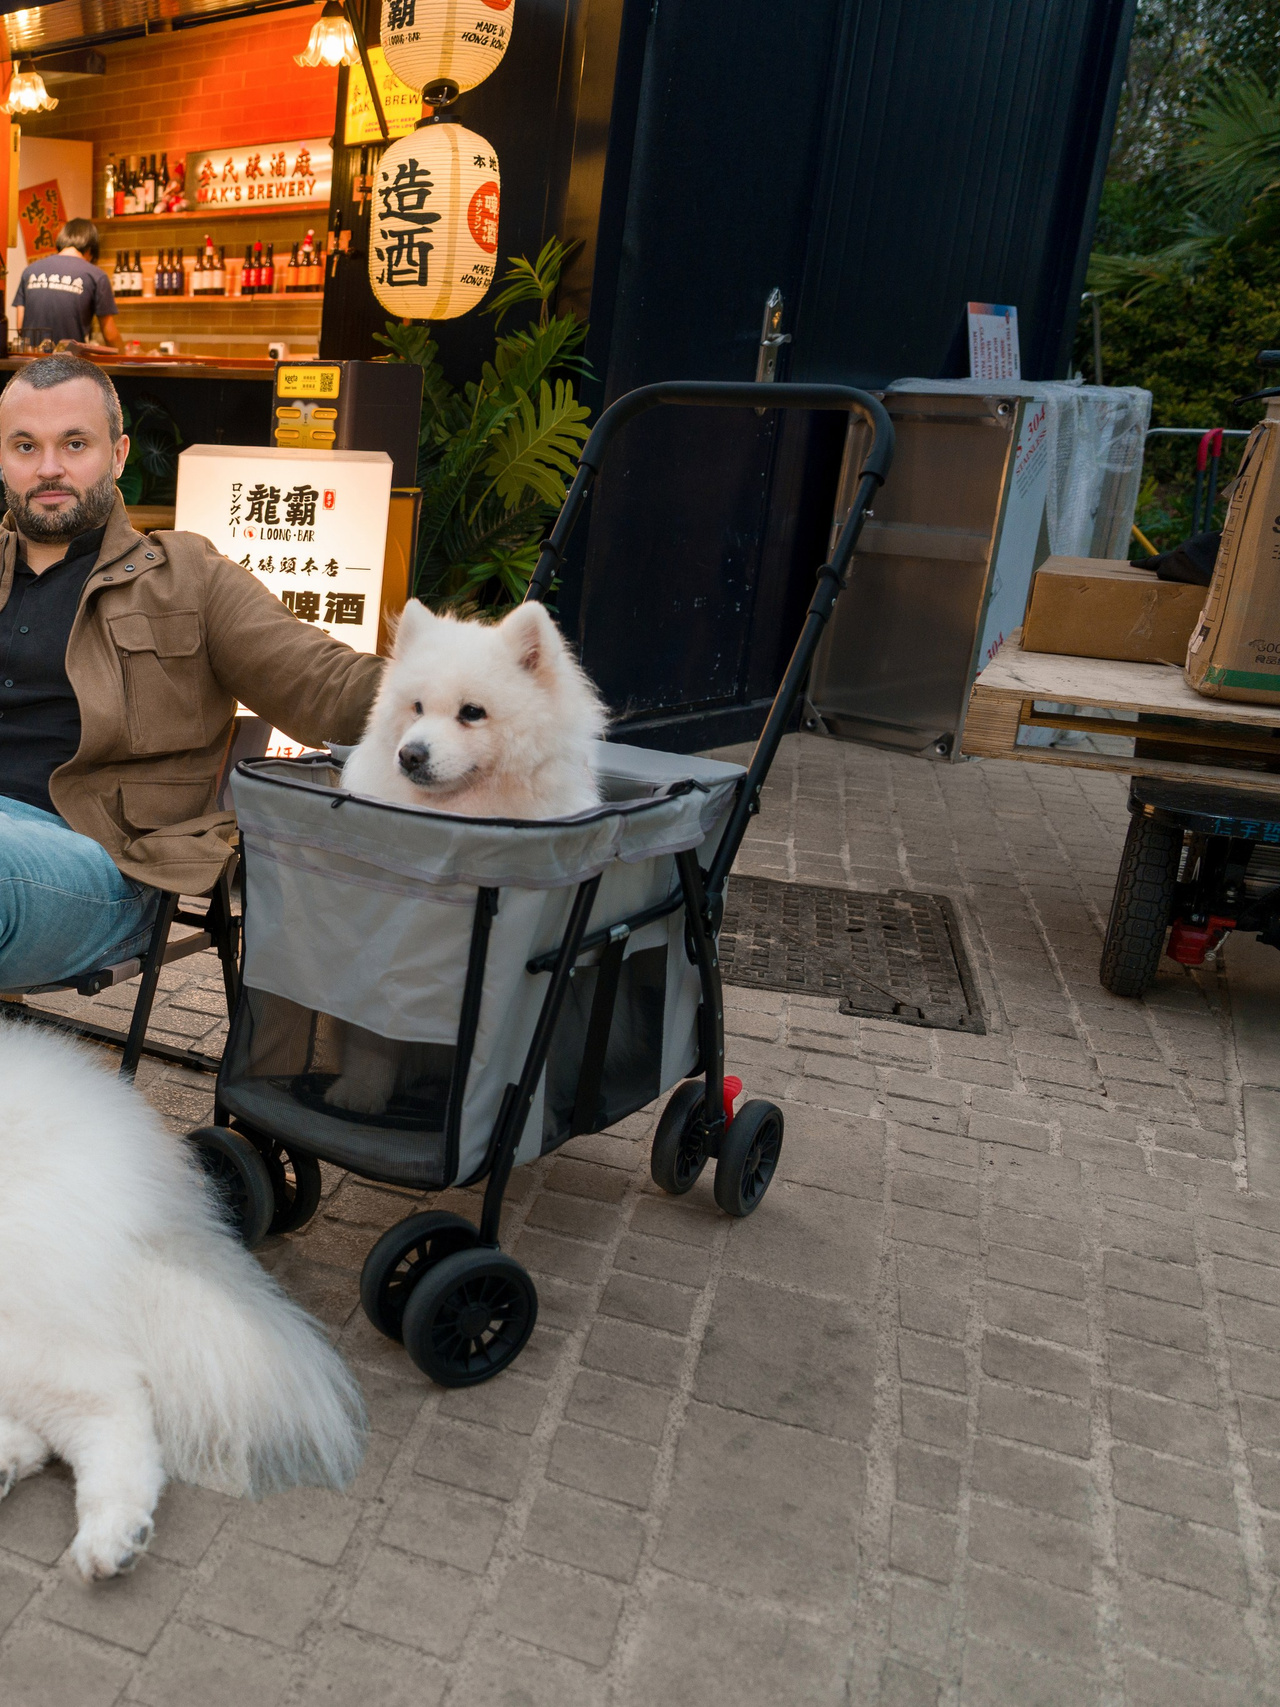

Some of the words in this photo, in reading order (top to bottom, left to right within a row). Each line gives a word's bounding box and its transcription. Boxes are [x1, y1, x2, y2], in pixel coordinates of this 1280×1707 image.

[461, 31, 488, 46] HONG
[475, 21, 498, 36] MADE
[385, 94, 421, 106] BREW
[196, 186, 242, 204] MAK'S
[247, 179, 316, 200] BREWERY
[375, 158, 442, 287] 造酒
[460, 274, 482, 287] HONG
[229, 483, 243, 537] ロングバー
[245, 483, 319, 526] 龍霸
[225, 553, 340, 578] 九碼頭本店
[282, 590, 366, 626] 啤酒
